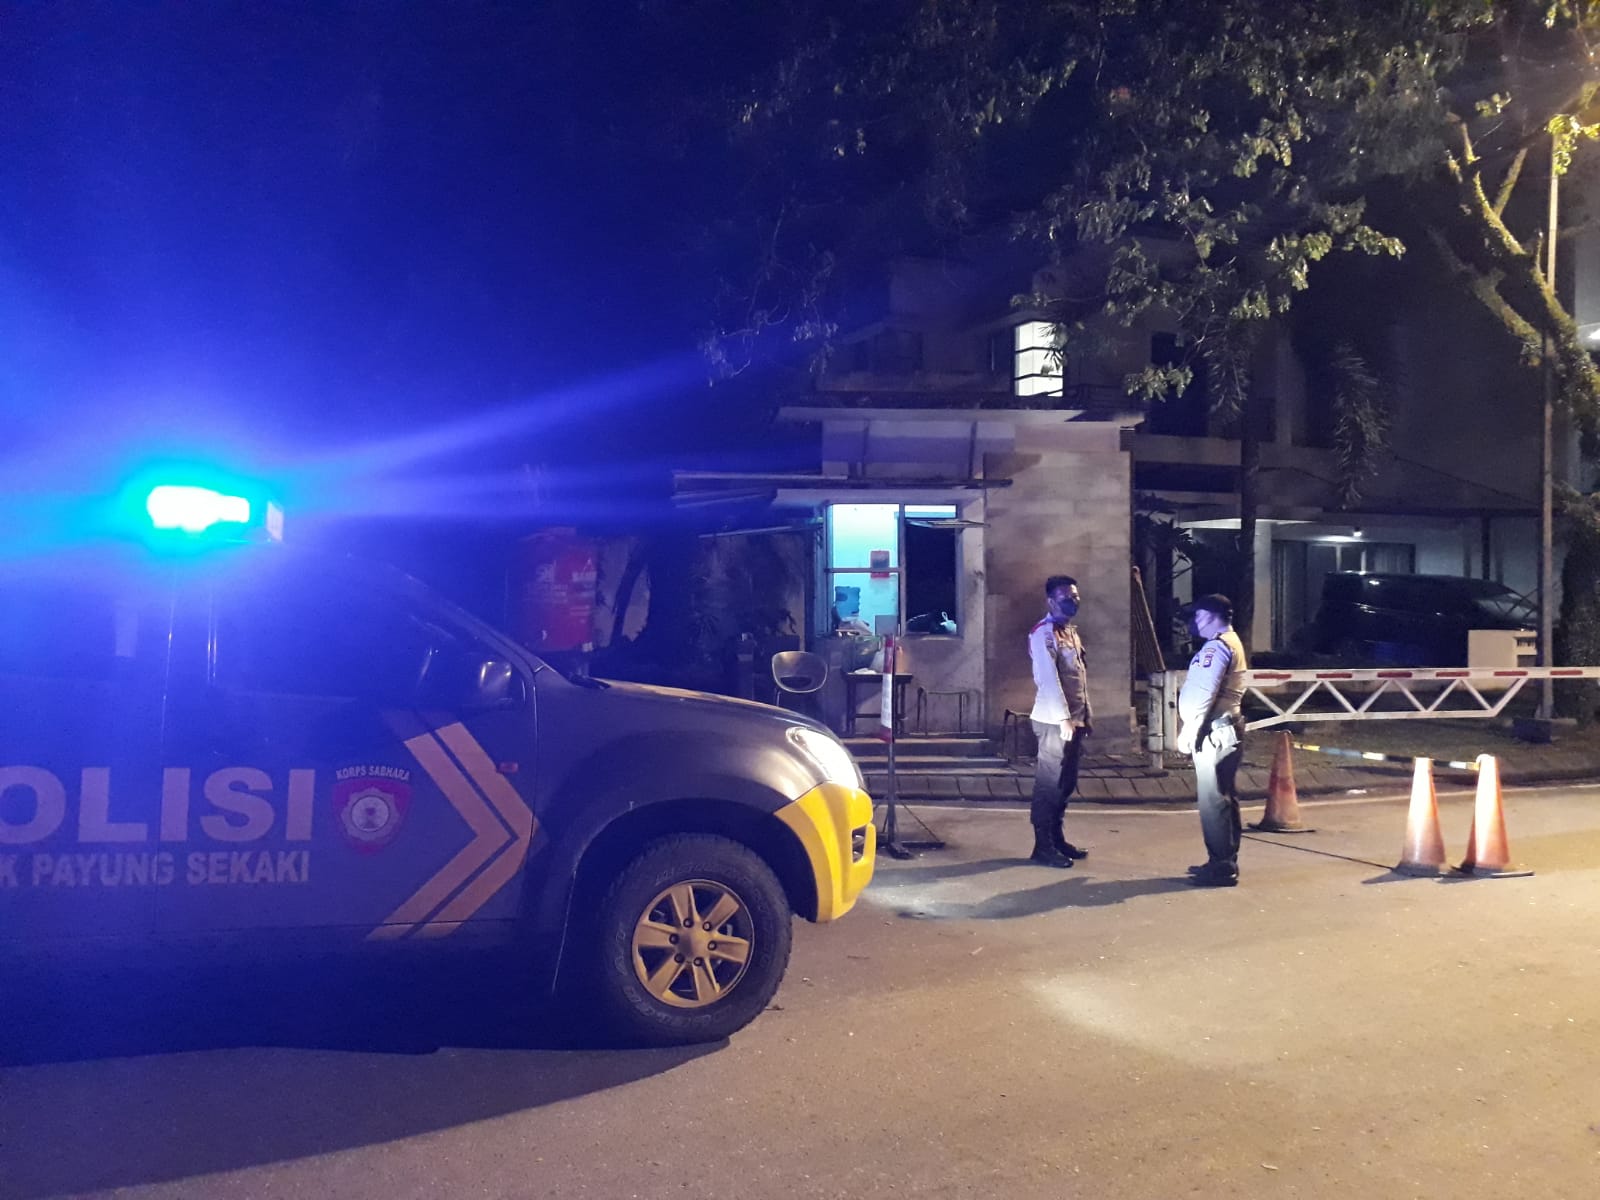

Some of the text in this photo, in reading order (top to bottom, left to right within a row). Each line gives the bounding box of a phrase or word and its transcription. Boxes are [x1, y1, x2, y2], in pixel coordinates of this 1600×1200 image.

[336, 765, 410, 781] KORPS SABHARA
[0, 765, 315, 843] OLISI
[32, 852, 175, 887] PAYUNG
[186, 851, 310, 885] SEKAKI
